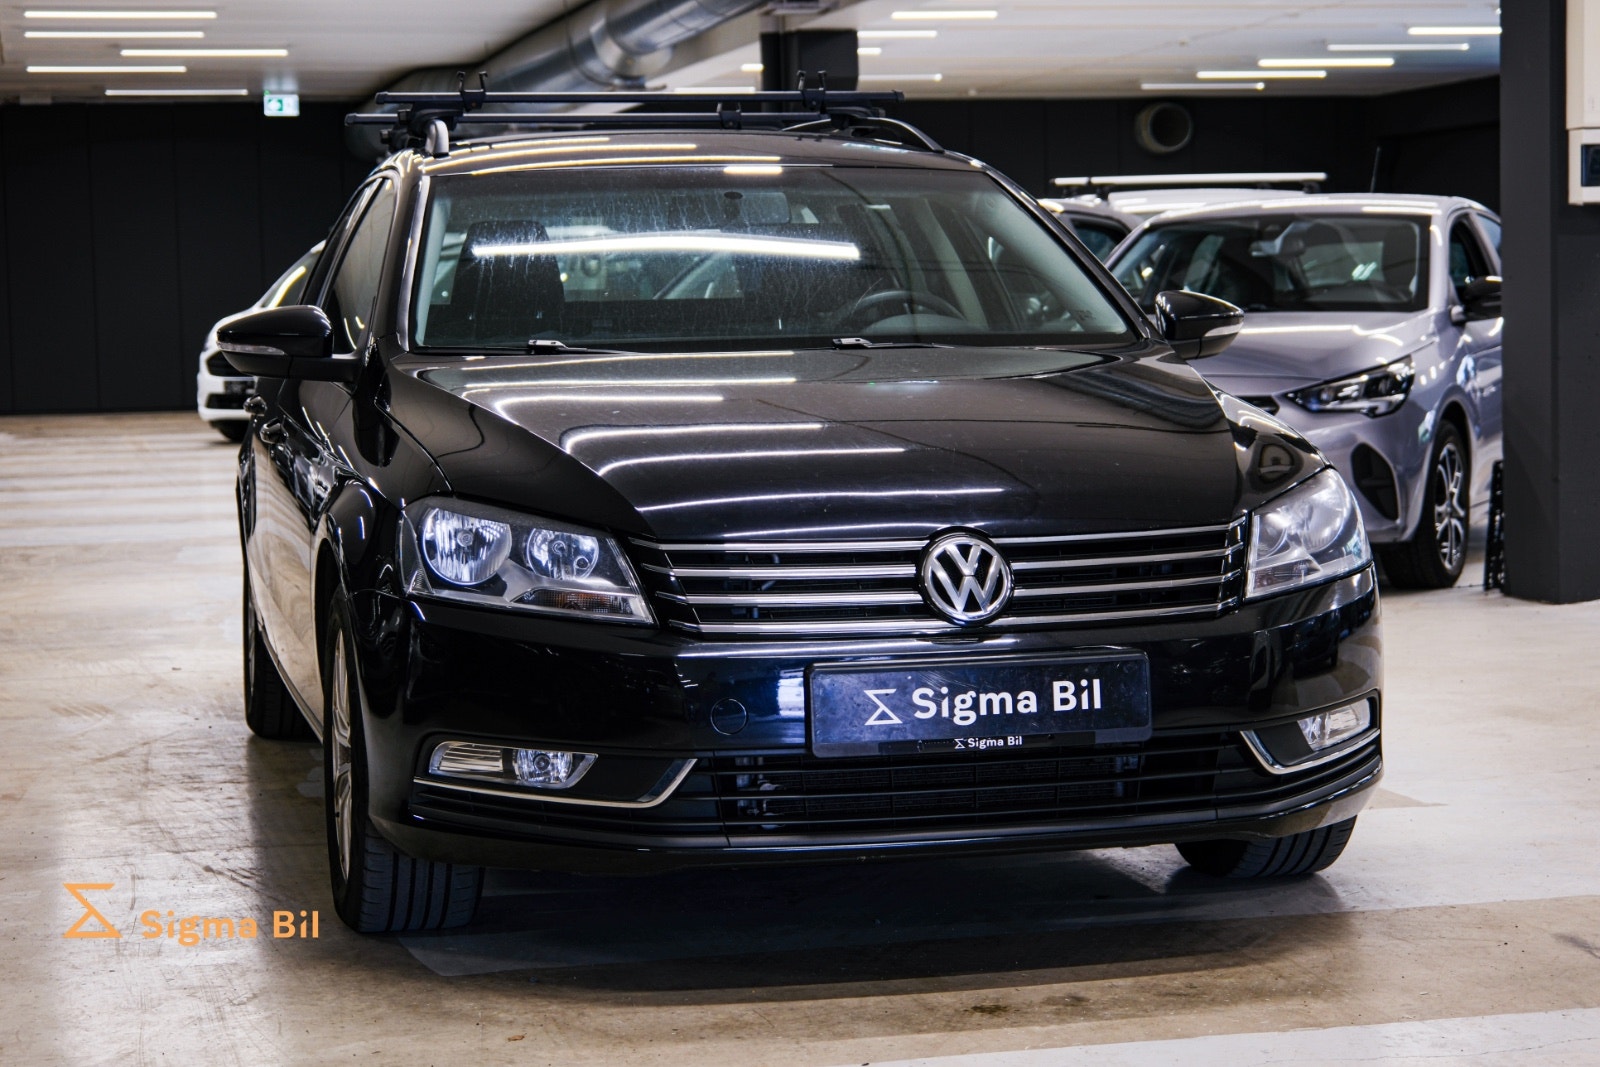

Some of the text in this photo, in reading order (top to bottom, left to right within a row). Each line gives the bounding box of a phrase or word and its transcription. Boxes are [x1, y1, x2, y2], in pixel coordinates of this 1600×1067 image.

[928, 541, 1001, 614] VW
[911, 678, 1102, 726] Sigma Bil
[967, 735, 1023, 750] Sigma Bil
